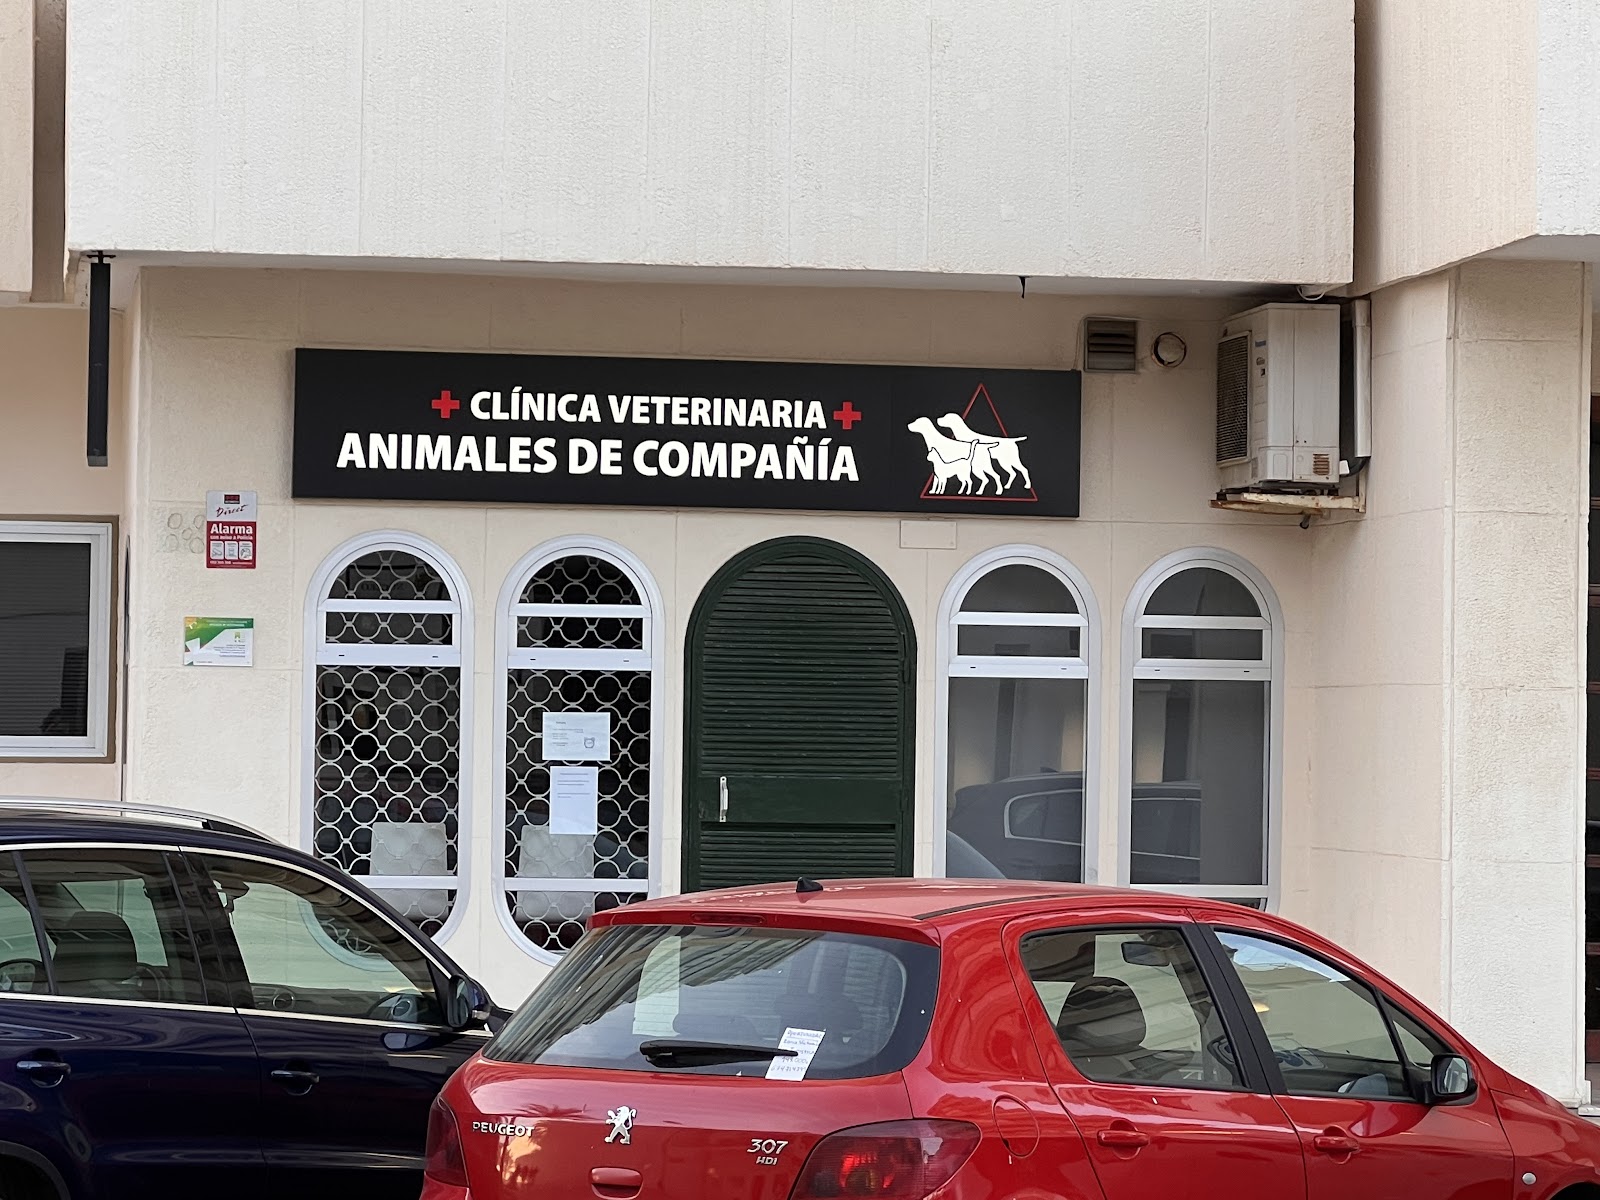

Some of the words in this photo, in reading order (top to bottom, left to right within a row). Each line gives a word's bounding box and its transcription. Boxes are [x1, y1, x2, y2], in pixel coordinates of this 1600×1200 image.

[470, 386, 602, 423] CLÍNICA
[607, 394, 827, 429] VETERINARIA
[336, 432, 558, 474] ANIMALES
[568, 438, 623, 475] DE
[632, 435, 860, 482] COMPAÑÍA
[210, 523, 253, 534] Alarma
[472, 1121, 535, 1138] PEUGEOT
[747, 1139, 789, 1155] 307
